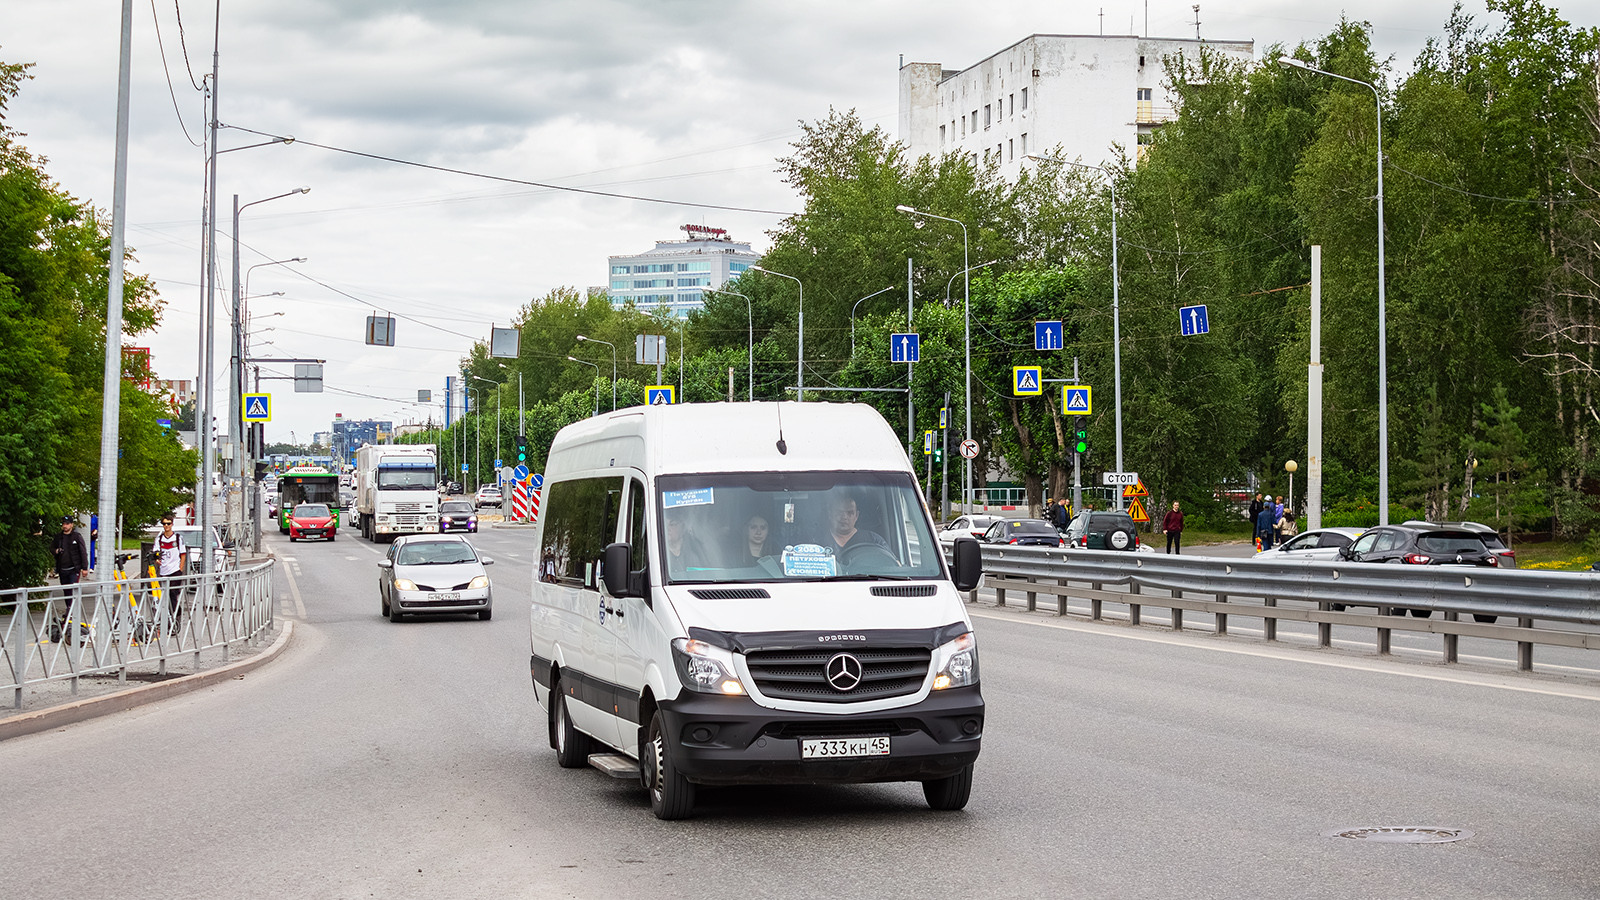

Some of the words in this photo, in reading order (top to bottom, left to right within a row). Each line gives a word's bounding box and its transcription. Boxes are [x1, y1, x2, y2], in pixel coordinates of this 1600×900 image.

[1108, 474, 1133, 483] СТОП
[818, 634, 867, 642] SPRINTER
[871, 738, 885, 750] 45
